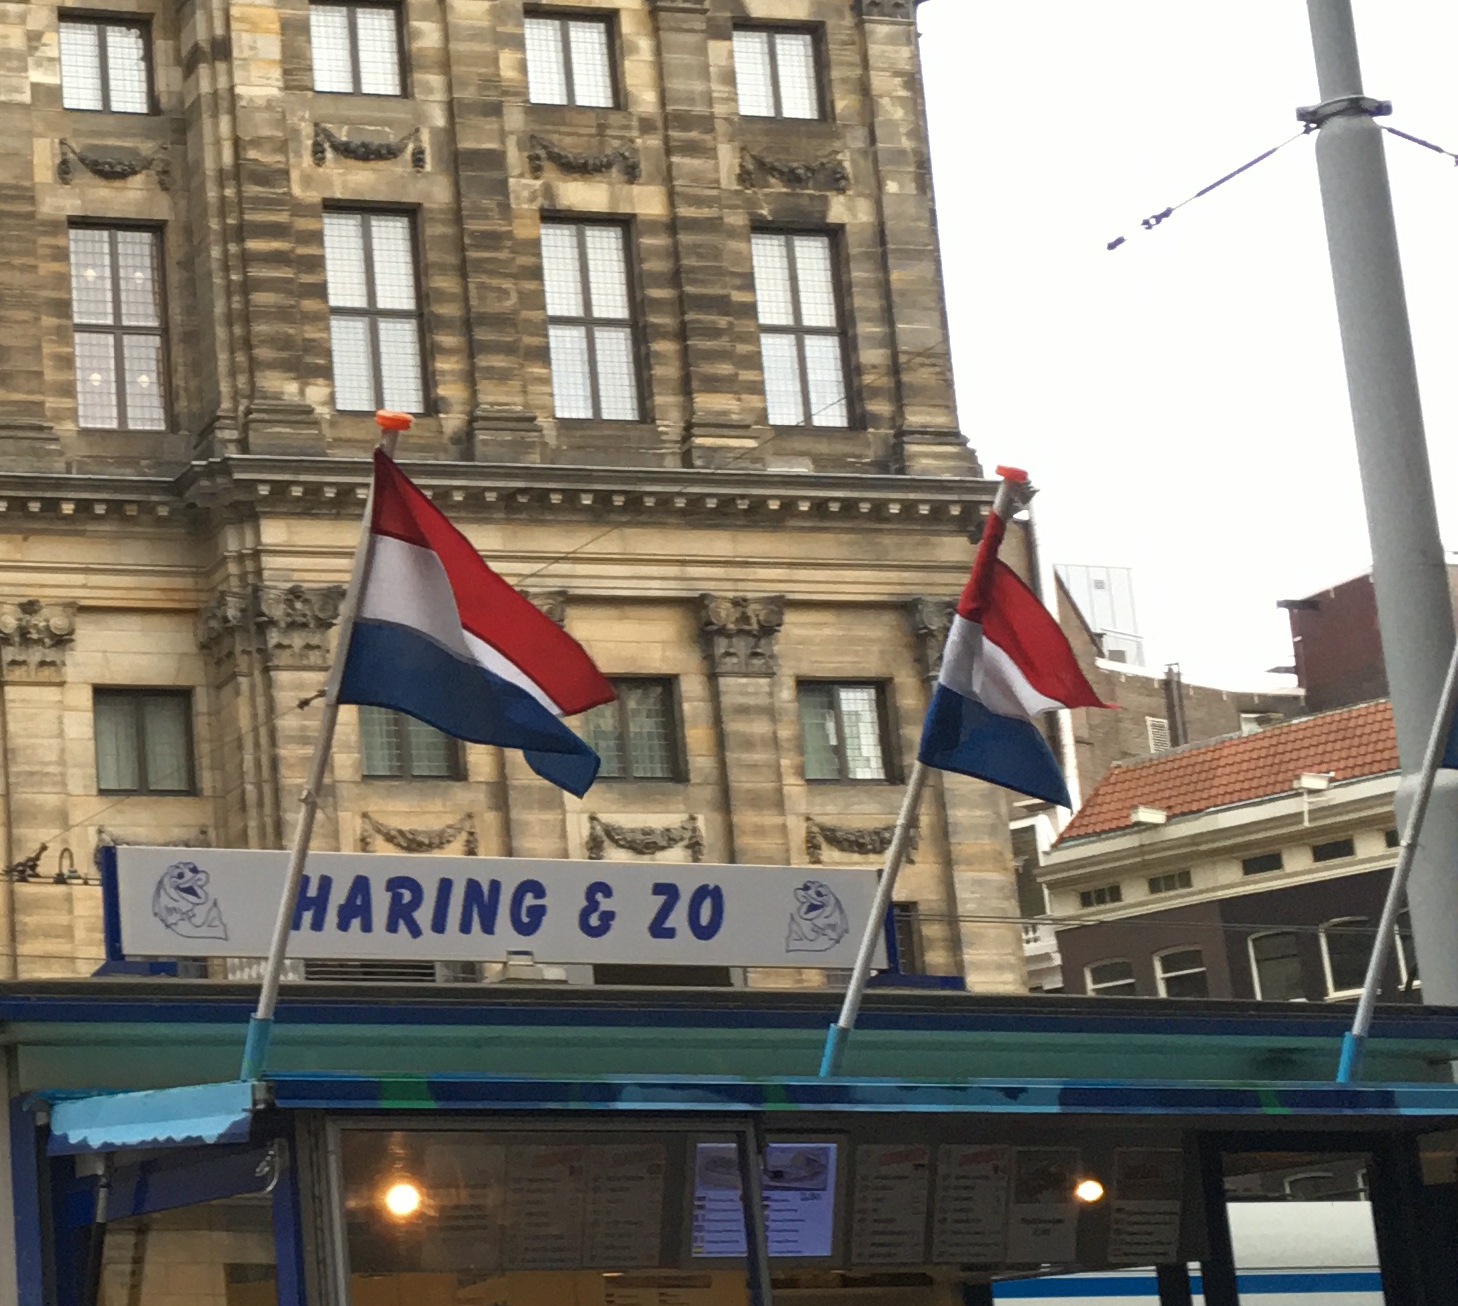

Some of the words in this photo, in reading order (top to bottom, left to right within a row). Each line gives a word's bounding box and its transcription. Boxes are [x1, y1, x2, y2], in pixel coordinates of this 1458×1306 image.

[291, 874, 547, 940] HARING
[578, 881, 616, 938] &
[647, 882, 725, 941] ZO
